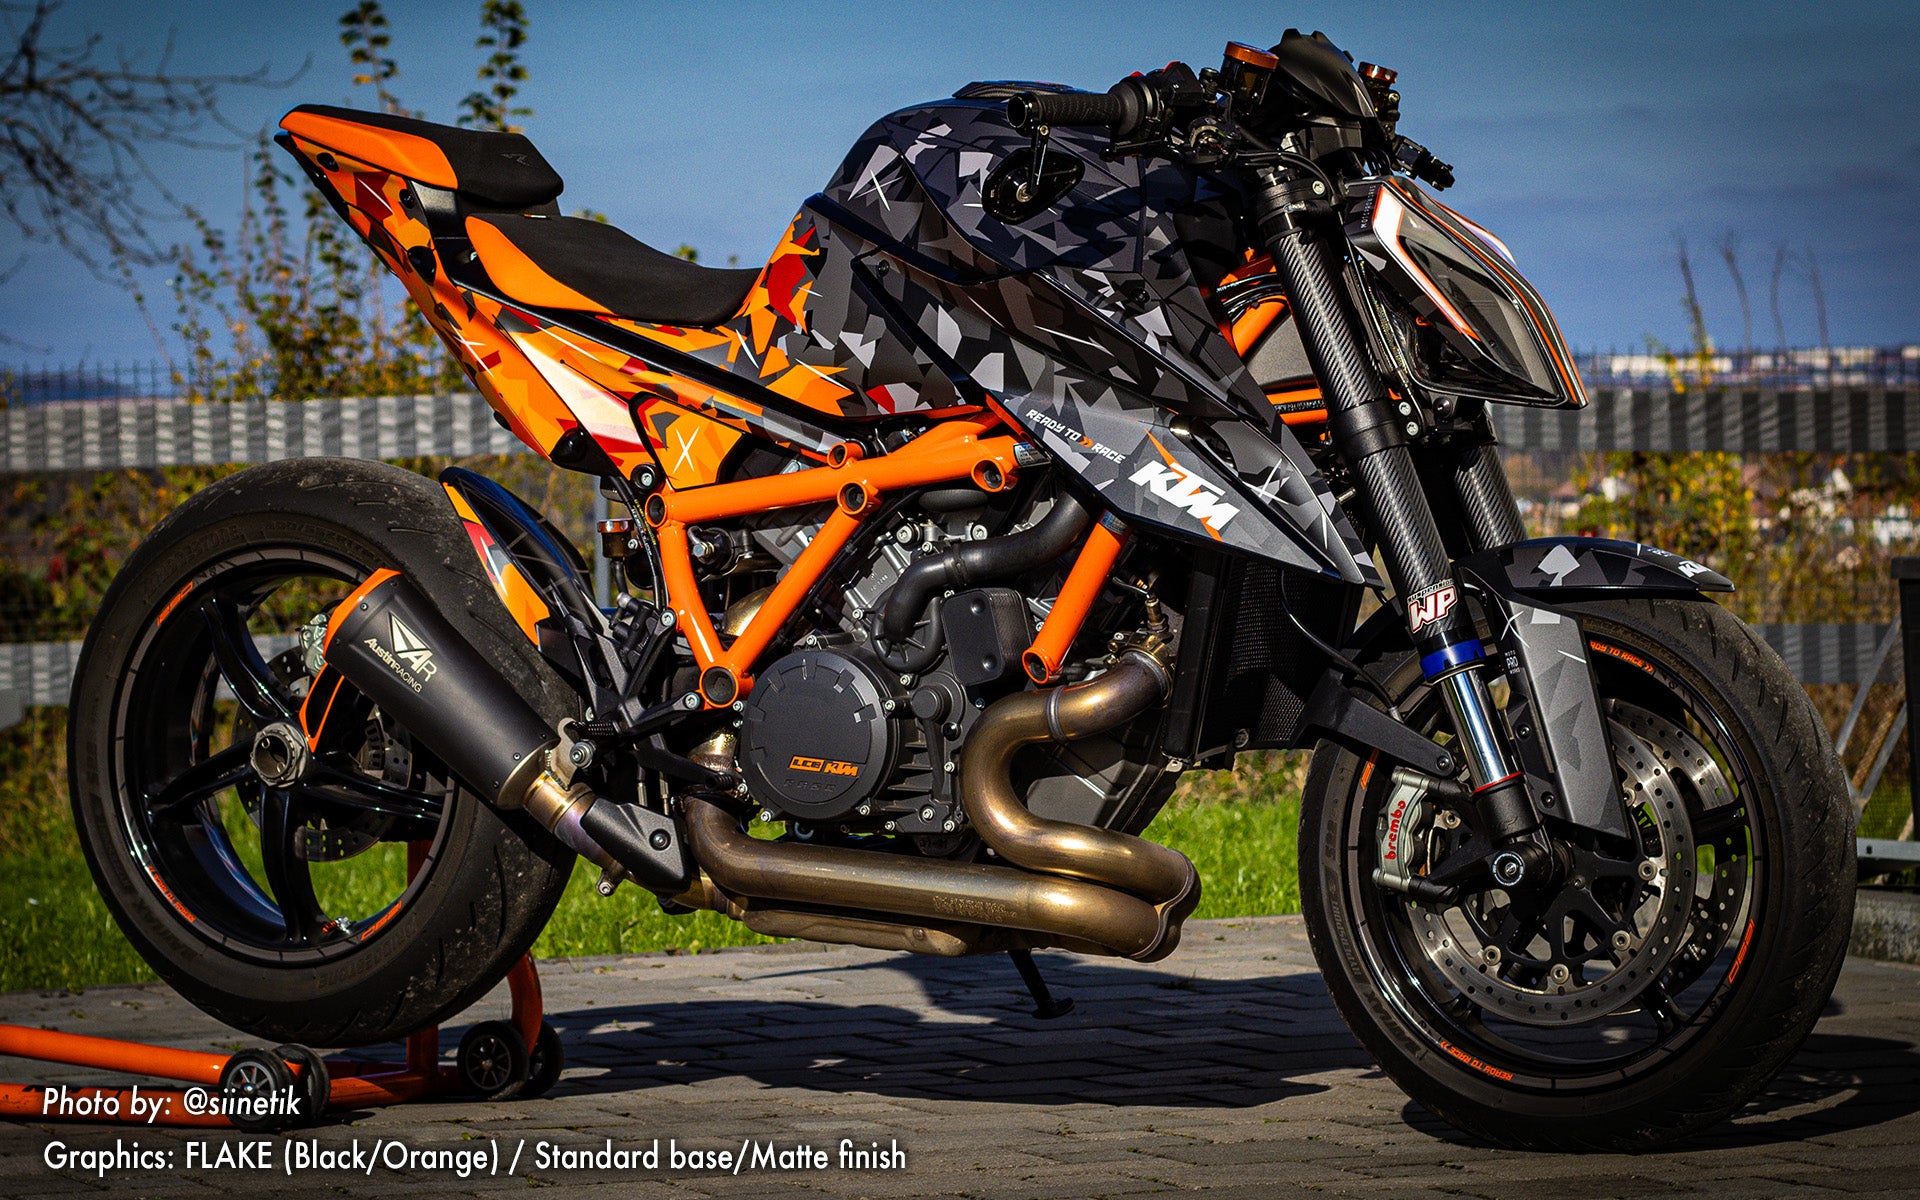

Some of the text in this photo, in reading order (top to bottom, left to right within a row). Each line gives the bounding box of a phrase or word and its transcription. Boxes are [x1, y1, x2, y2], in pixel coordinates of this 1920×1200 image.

[1025, 408, 1127, 464] READY TO RACE
[1128, 459, 1241, 531] KTM
[1408, 585, 1457, 633] WP
[823, 760, 859, 777] KTM
[1384, 800, 1406, 860] brembo
[1447, 1046, 1514, 1081] READY TO RACE
